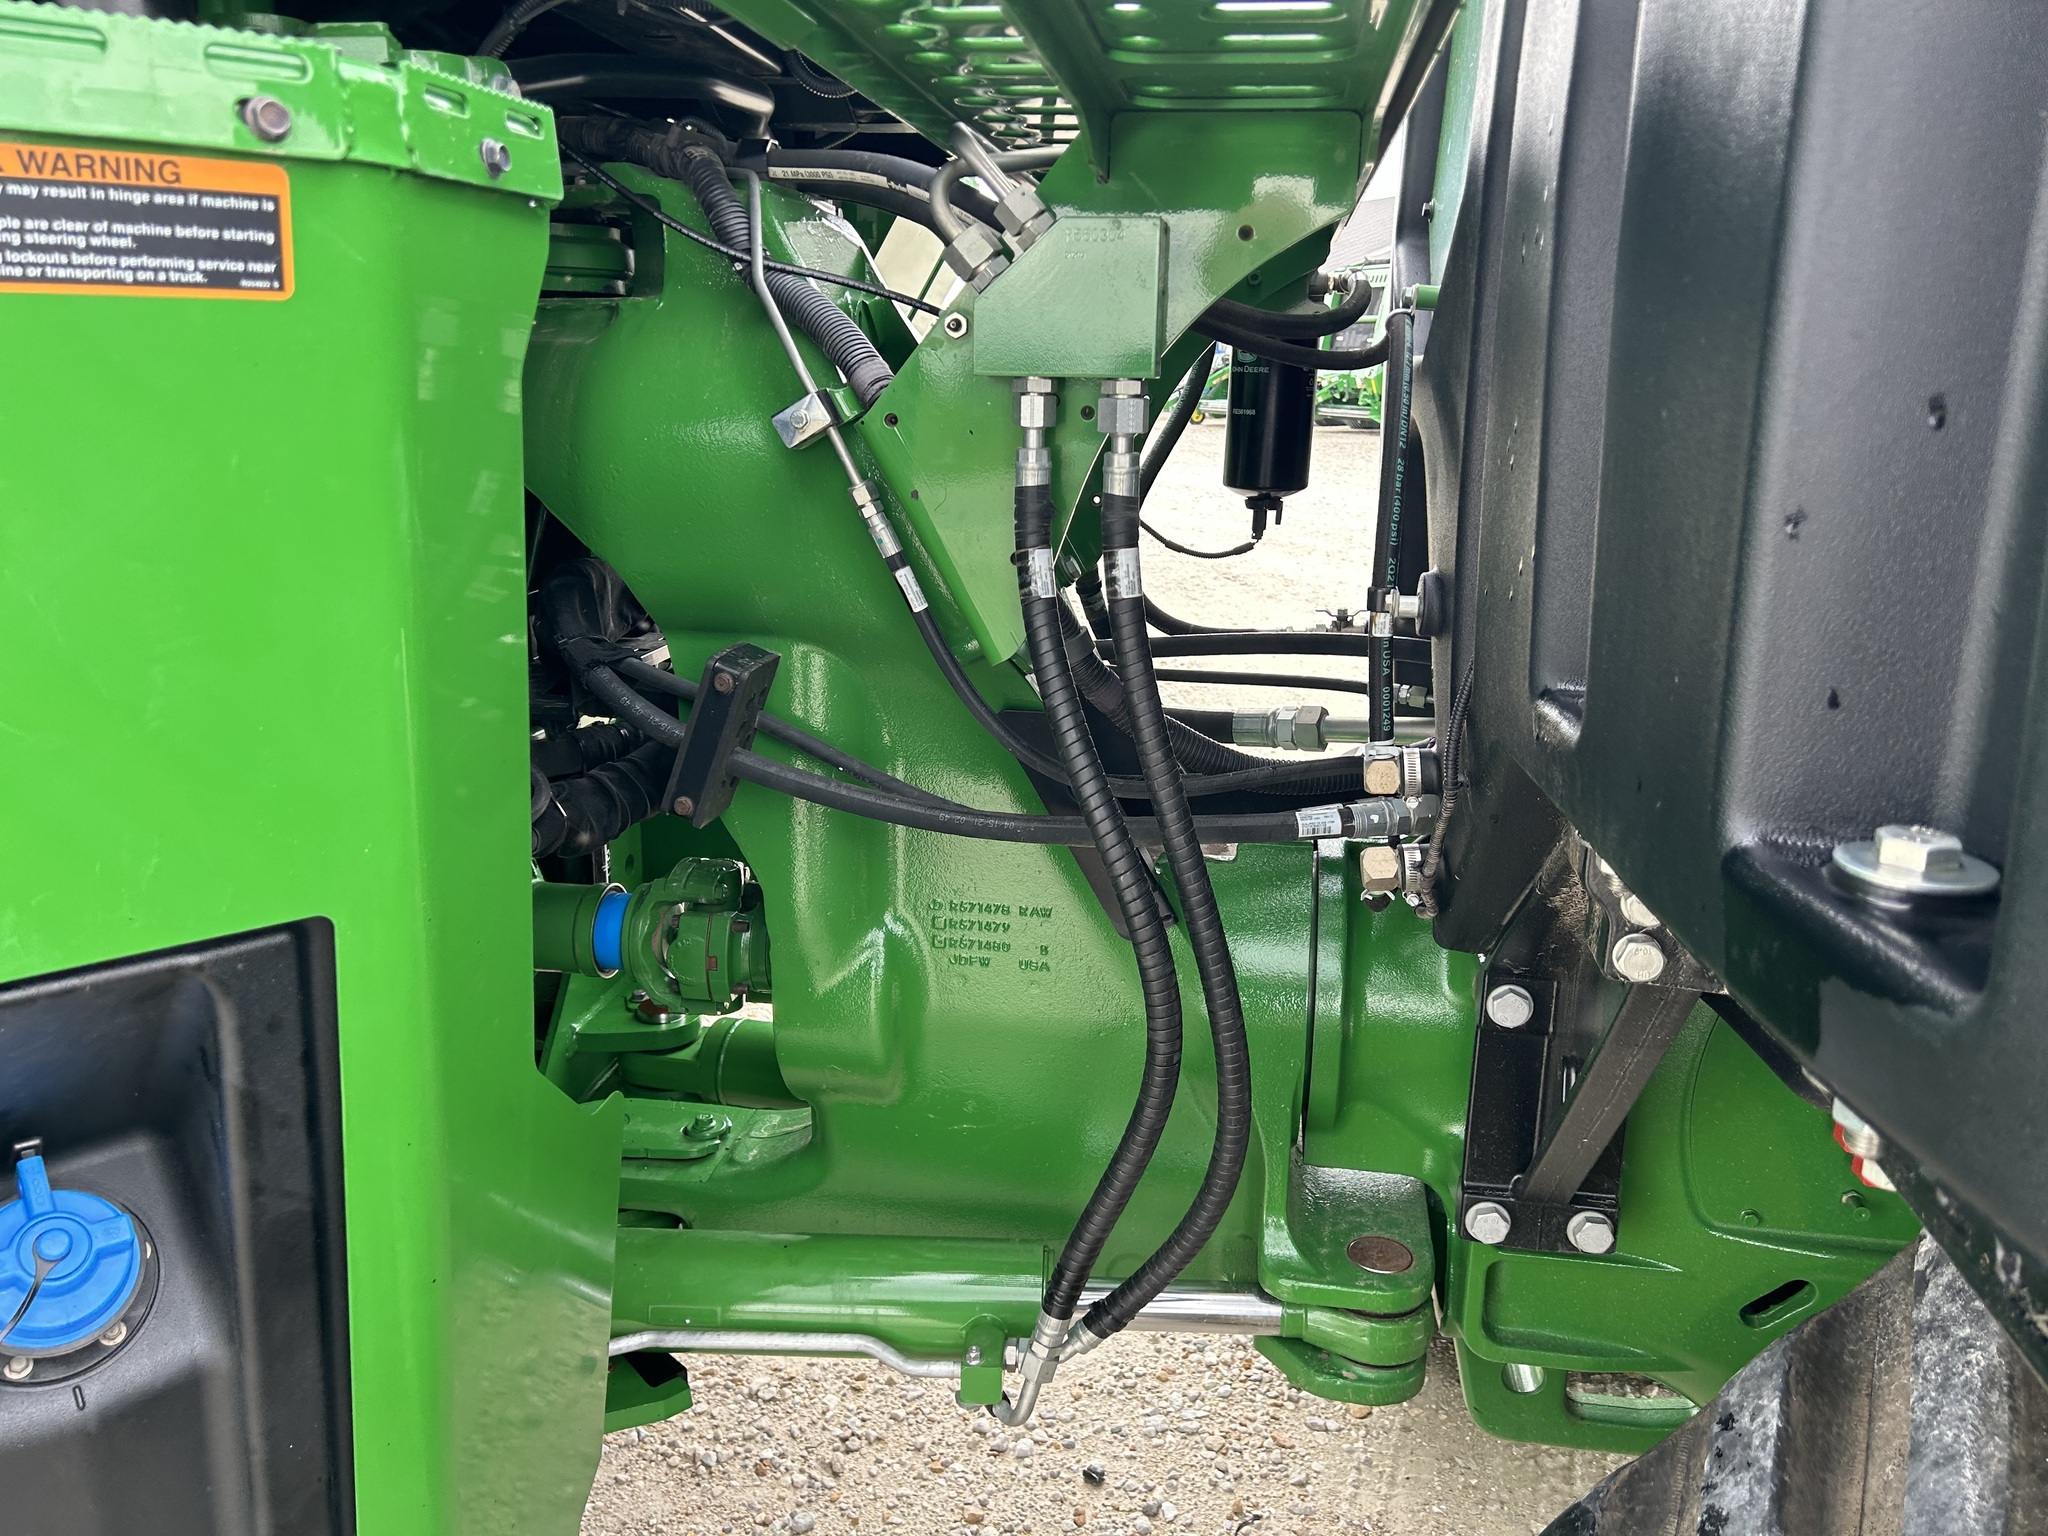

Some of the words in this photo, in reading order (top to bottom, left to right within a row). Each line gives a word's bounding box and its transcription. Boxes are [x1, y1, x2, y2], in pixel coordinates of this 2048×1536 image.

[16, 149, 182, 185] WARNING
[5, 183, 39, 199] may
[41, 185, 87, 199] result
[89, 187, 105, 201] in
[107, 188, 150, 206] hinge
[152, 191, 185, 206] area
[186, 192, 199, 206] if
[201, 195, 259, 212] machine
[261, 198, 275, 212] is
[23, 218, 49, 231] are
[51, 217, 90, 233] clear
[91, 219, 108, 234] of
[110, 221, 172, 238] machine
[174, 224, 220, 240] before
[222, 227, 275, 246] starting
[23, 232, 87, 249] steering
[88, 235, 138, 249] wheel.
[4, 249, 69, 264] lockouts
[70, 251, 118, 266] before
[119, 254, 195, 271] performing
[197, 257, 246, 273] service
[247, 259, 278, 274] near
[25, 266, 43, 278] or
[45, 265, 134, 283] transporting
[135, 268, 154, 281] on
[157, 271, 167, 282] a
[168, 270, 208, 284] truck.
[1244, 365, 1270, 374] DEERE
[1403, 366, 1411, 382] mm
[1399, 419, 1408, 449] DN12
[1397, 457, 1405, 472] 28
[1394, 473, 1403, 492] bar
[1392, 495, 1402, 521] (400
[1389, 522, 1399, 546] psi)
[1386, 557, 1396, 588] 2Q21
[1382, 650, 1391, 676] USA
[1382, 686, 1391, 732] 0001249
[973, 818, 1015, 829] 04/15/21
[1018, 905, 1053, 919] RAW
[948, 918, 1011, 933] R571479
[1018, 958, 1051, 972] USA
